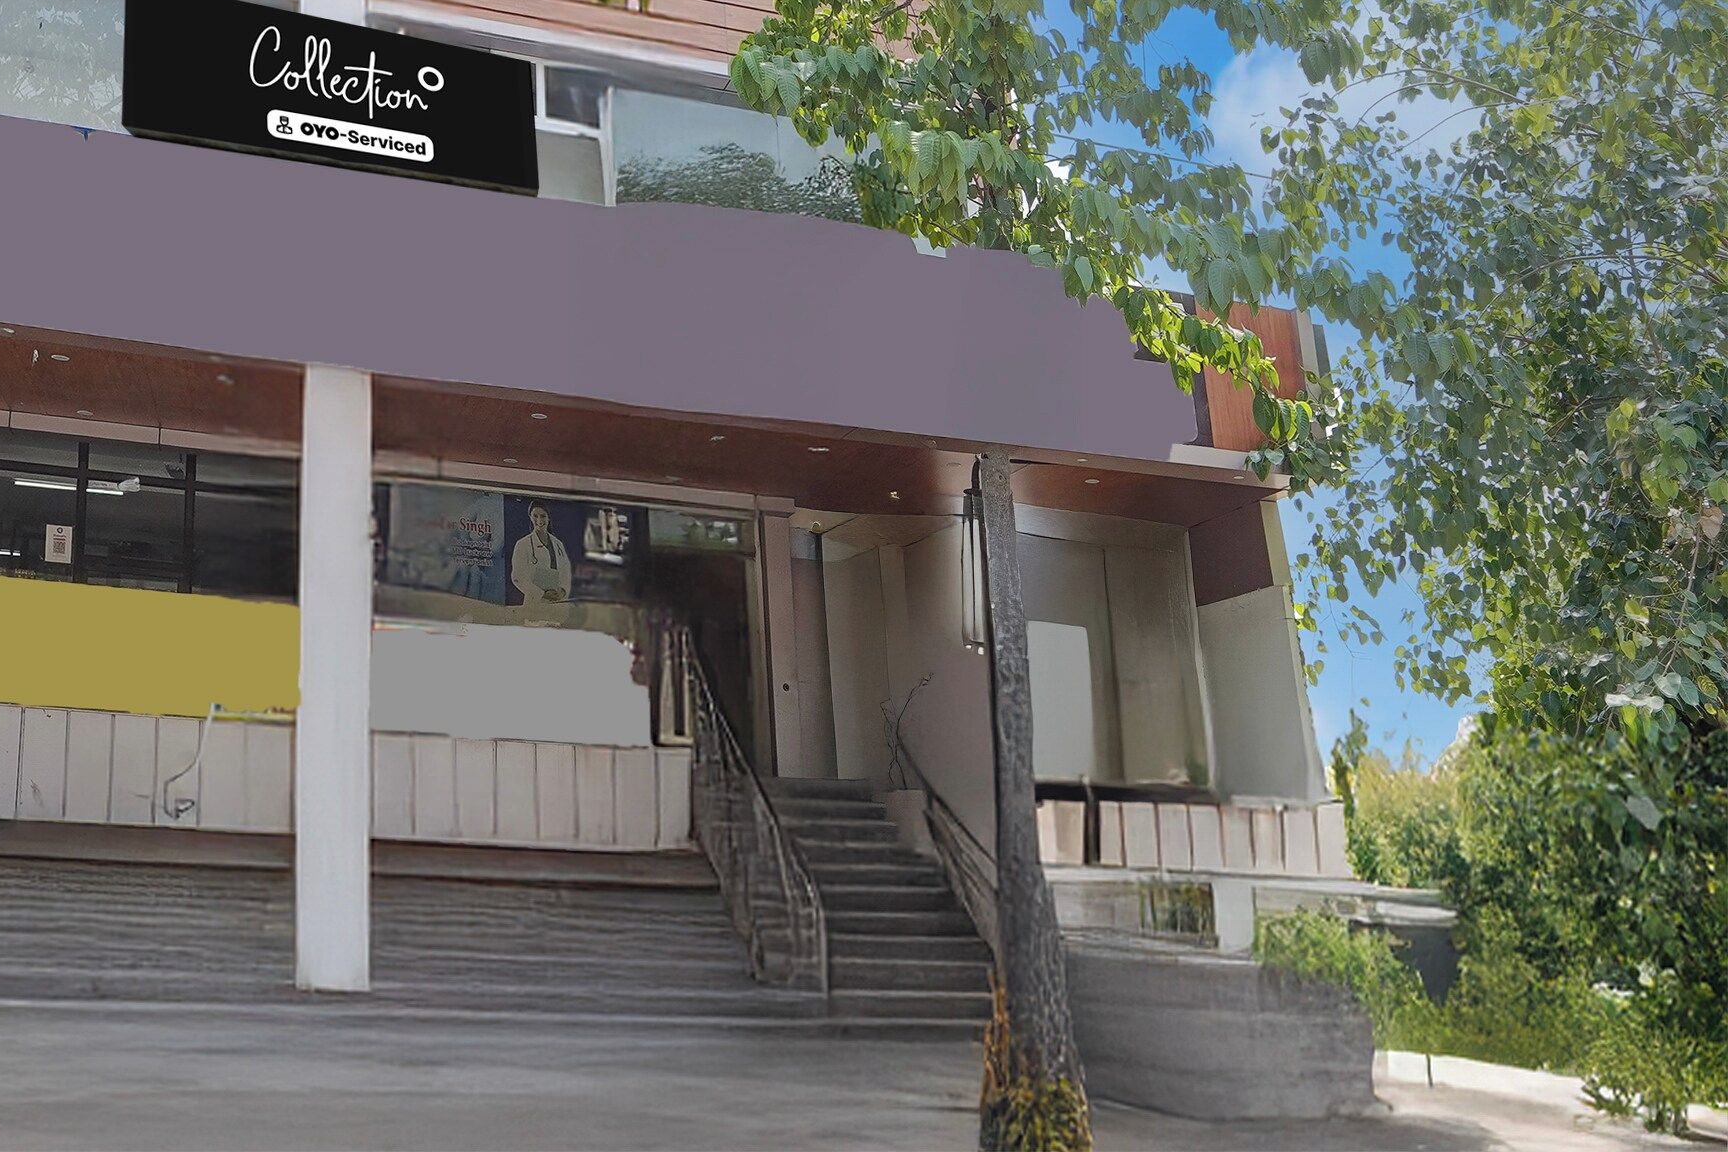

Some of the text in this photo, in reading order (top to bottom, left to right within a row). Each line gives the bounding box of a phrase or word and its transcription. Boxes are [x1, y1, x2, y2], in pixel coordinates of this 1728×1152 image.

[249, 25, 429, 120] Collection
[300, 121, 427, 156] OYO-Serviced
[459, 517, 491, 536] Singh
